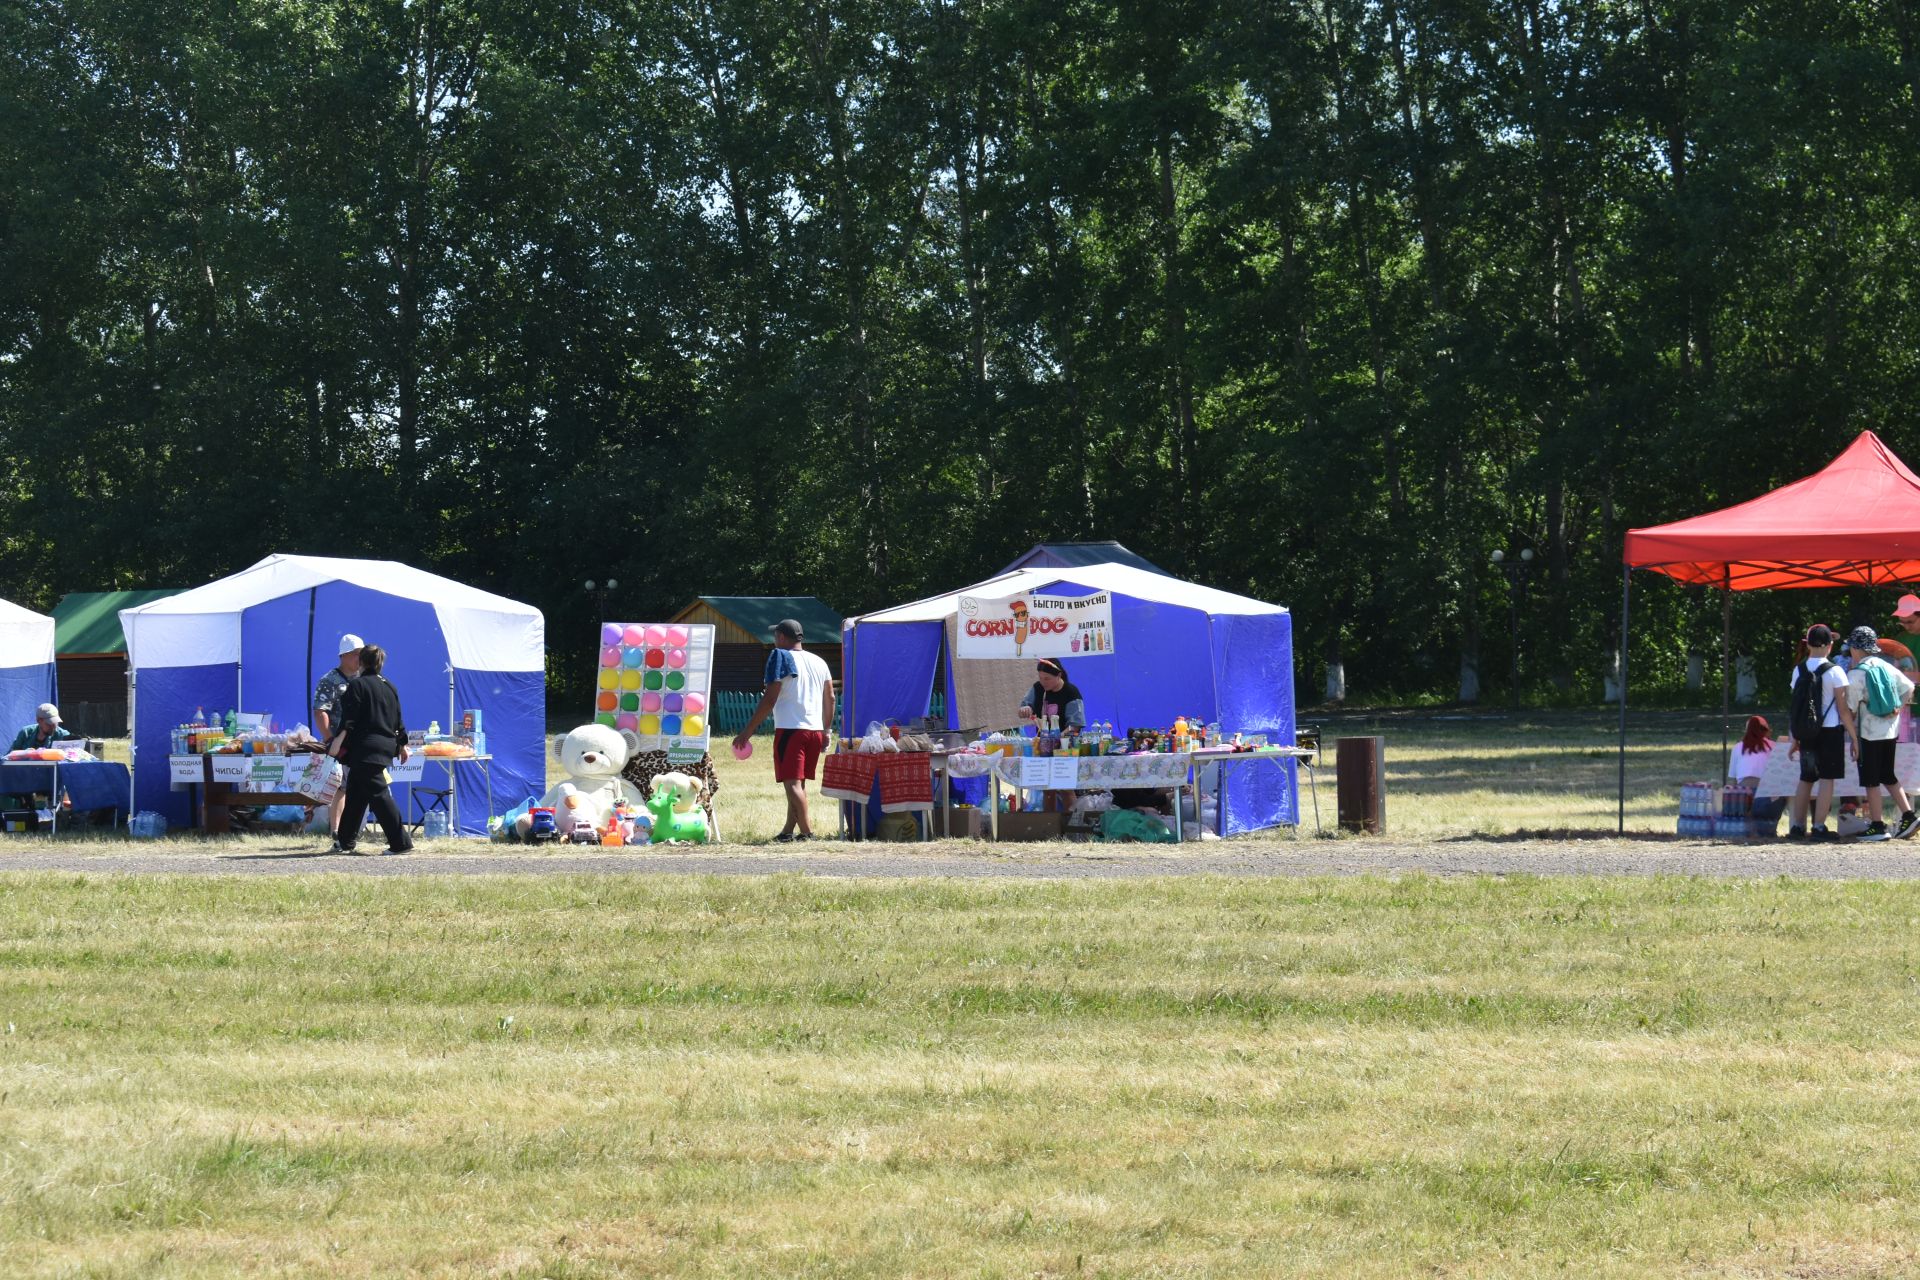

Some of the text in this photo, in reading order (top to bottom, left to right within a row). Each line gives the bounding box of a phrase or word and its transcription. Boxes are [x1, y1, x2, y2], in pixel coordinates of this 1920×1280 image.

[1033, 595, 1107, 610] БЫСТРО И ВКУСНО
[966, 617, 1068, 637] CORN DOG
[1078, 620, 1105, 630] НАПИТКИ
[215, 767, 243, 775] ЧИПСЫ
